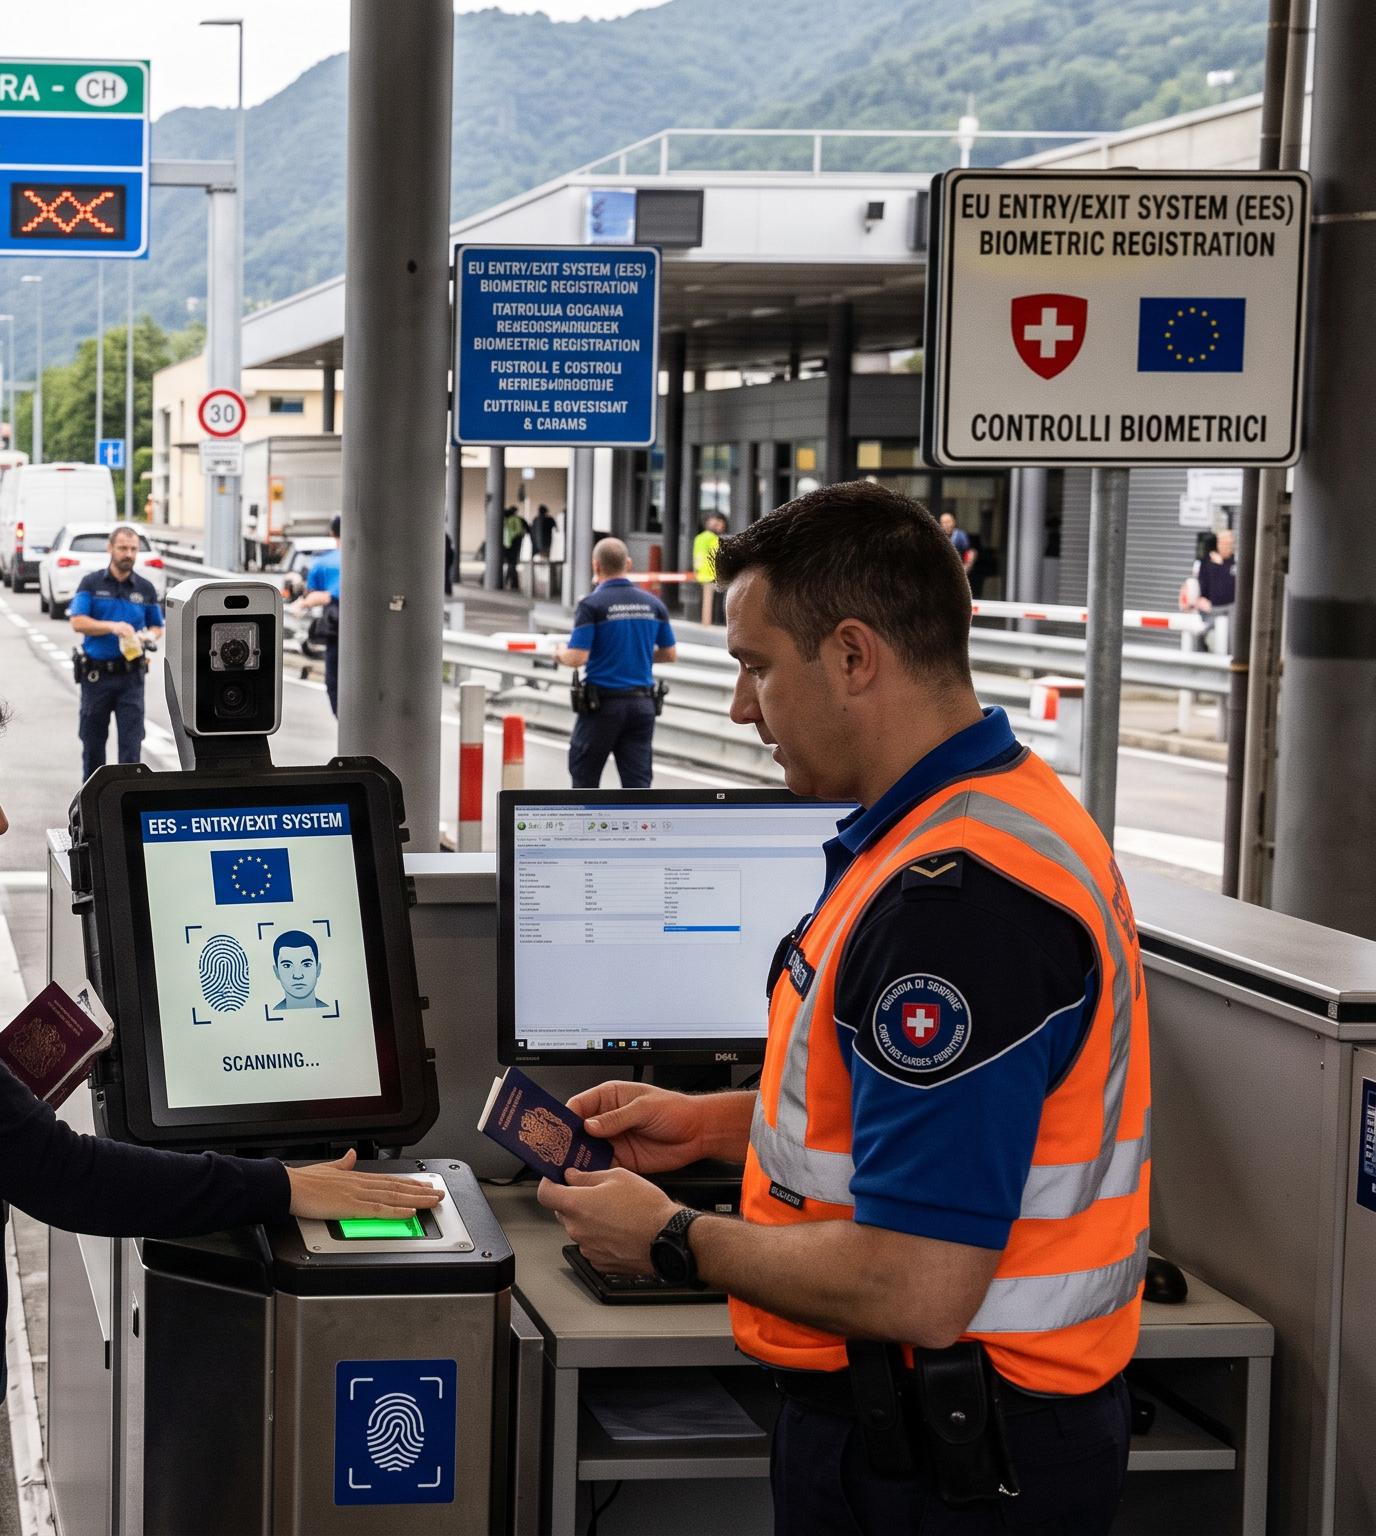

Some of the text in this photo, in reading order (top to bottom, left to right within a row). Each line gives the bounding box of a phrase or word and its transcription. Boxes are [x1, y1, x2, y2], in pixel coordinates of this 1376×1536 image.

[87, 79, 116, 99] CH
[962, 194, 1294, 226] EU ENTRY/EXIT SYSTEM (EES)
[981, 231, 1274, 256] BIOMETRIC REGISTRATION
[469, 262, 647, 279] EU ENTRY/EXIT SYSTEM (EES)
[481, 280, 638, 293] BIOMETRIC REGISTRATION
[553, 339, 639, 351] REGISTRATION
[553, 362, 559, 373] E
[211, 404, 235, 423] 30
[524, 418, 532, 429] &
[972, 414, 1266, 442] CONTROLLI BIOMETRICI
[149, 819, 176, 834] EES
[192, 815, 277, 832] ENTRY/EXIT
[283, 813, 342, 829] SYSTEM
[223, 1052, 319, 1071] SCANNING...
